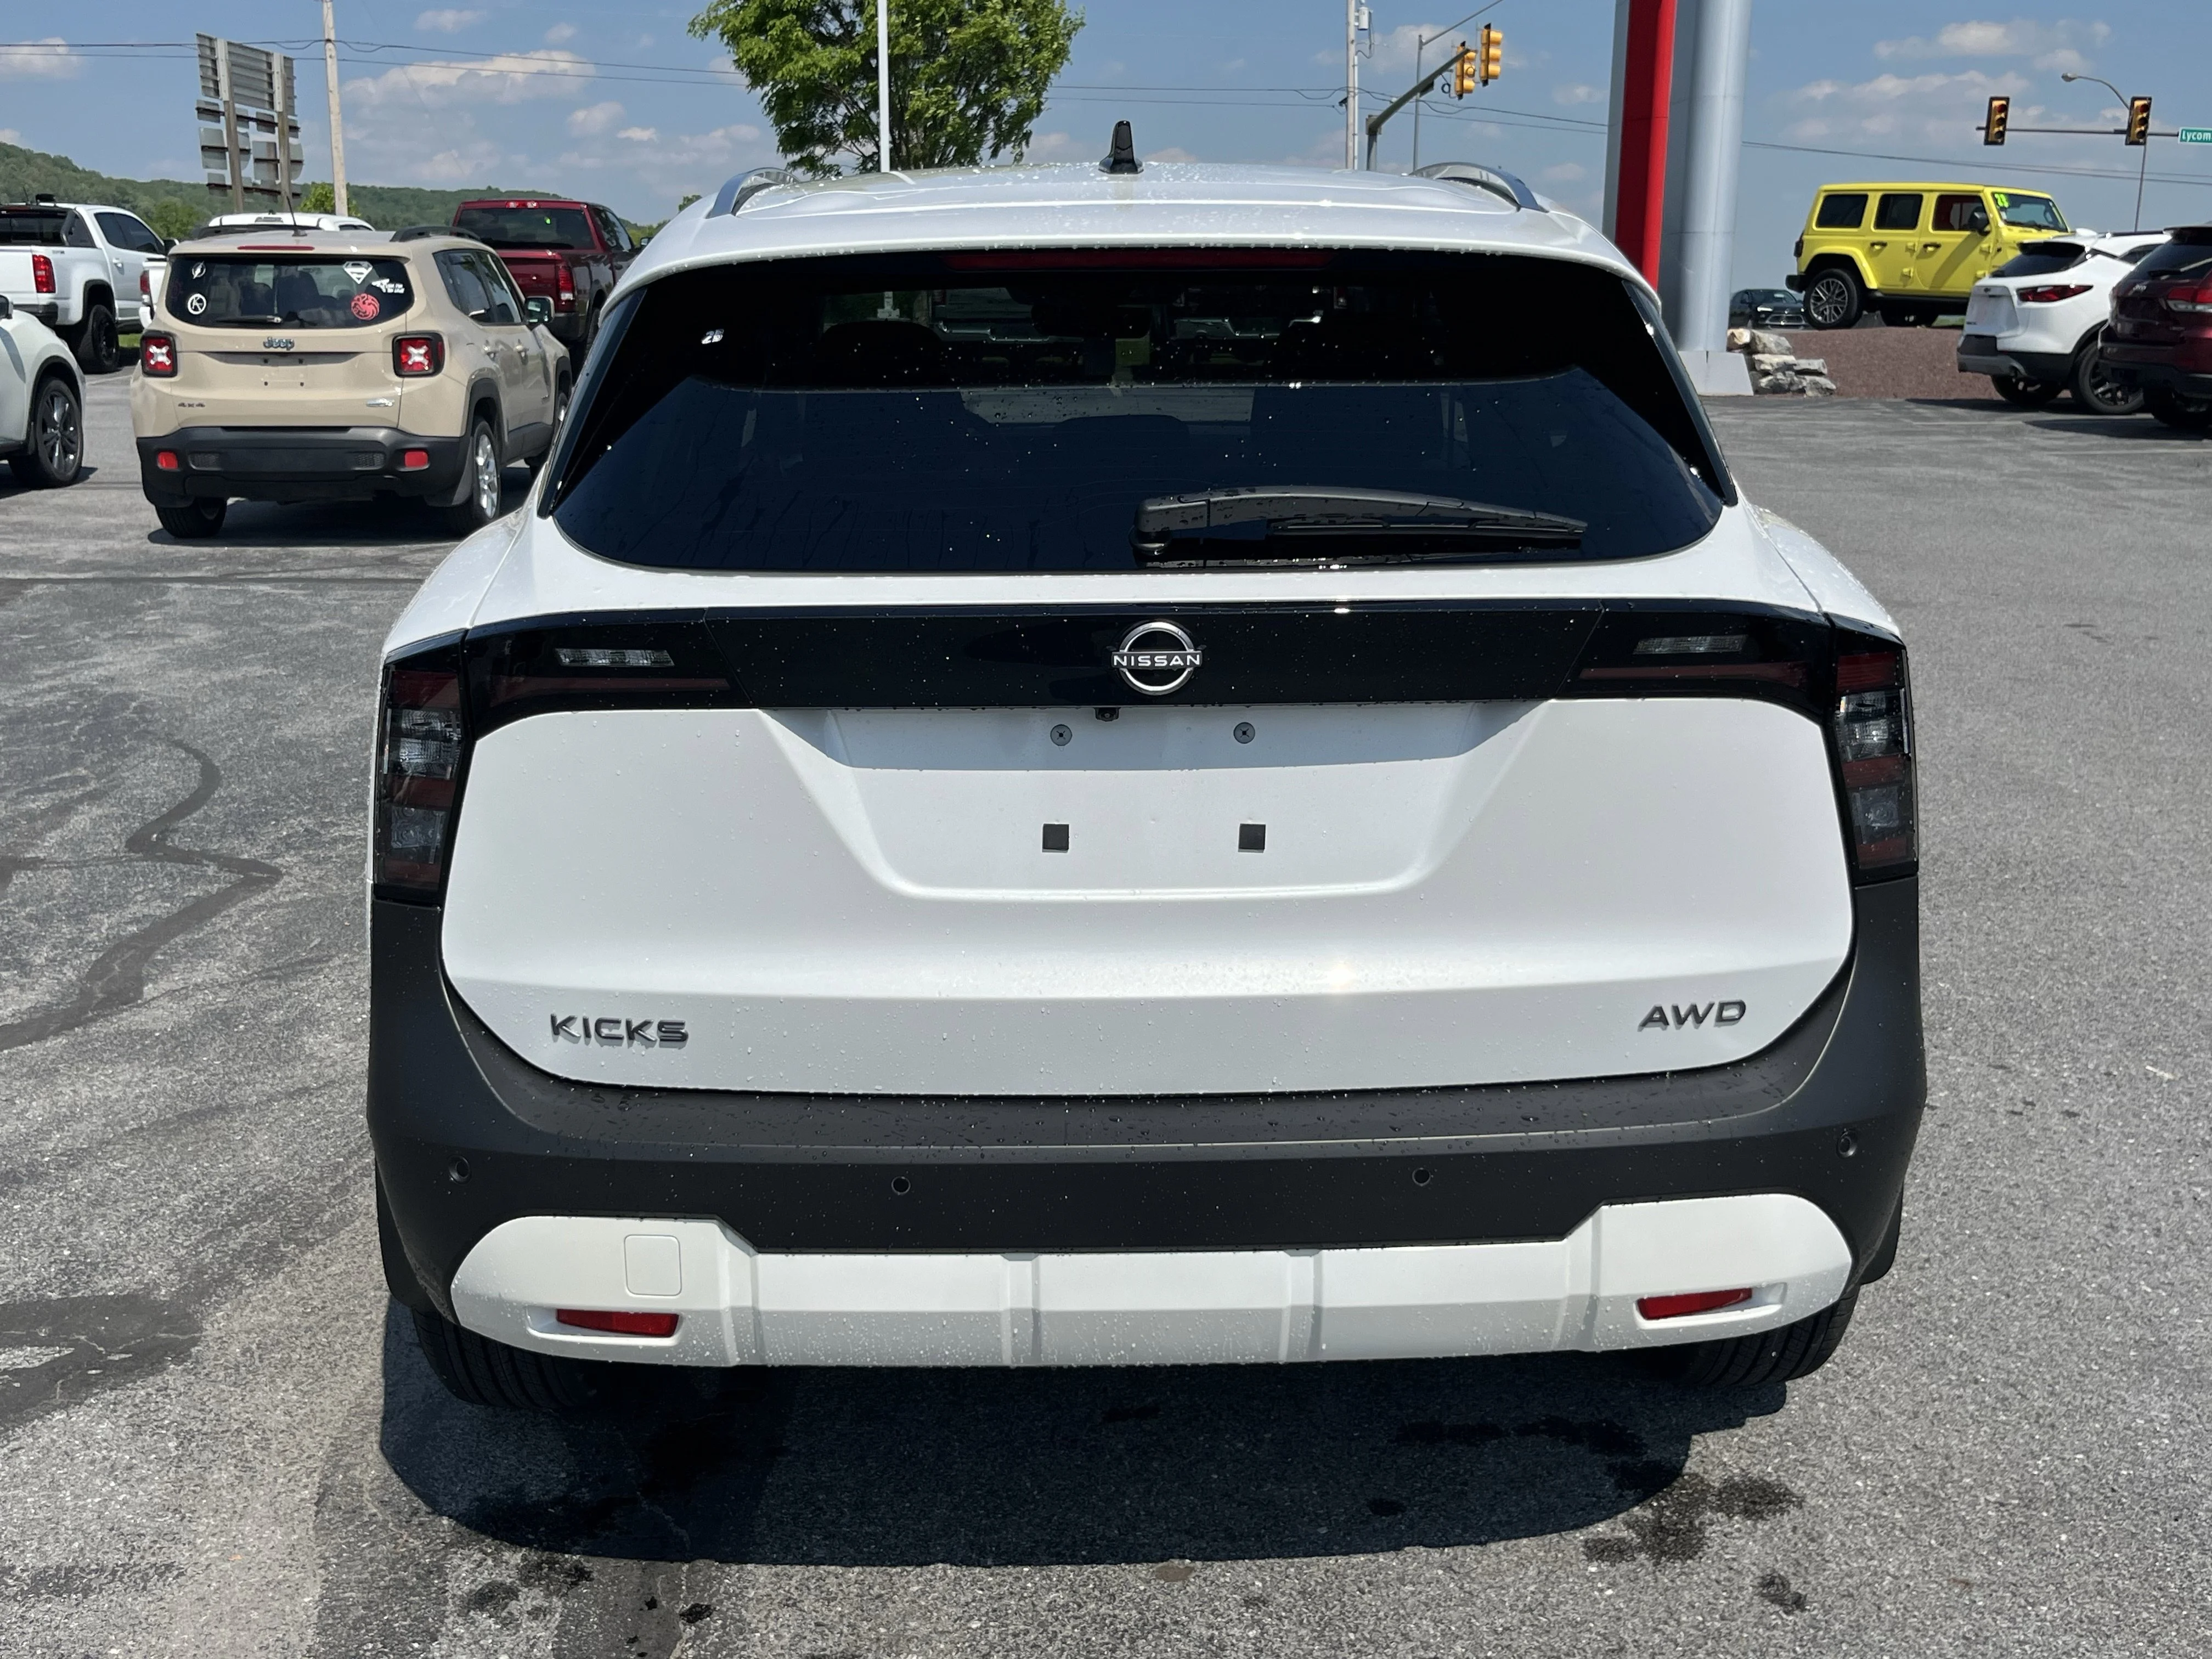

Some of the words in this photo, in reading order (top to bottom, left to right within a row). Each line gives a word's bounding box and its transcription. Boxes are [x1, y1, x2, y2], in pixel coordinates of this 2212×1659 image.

[263, 336, 295, 351] Jeep
[1113, 654, 1200, 667] NISSAN
[1639, 999, 1746, 1028] AWD
[550, 1013, 689, 1043] KICKS
